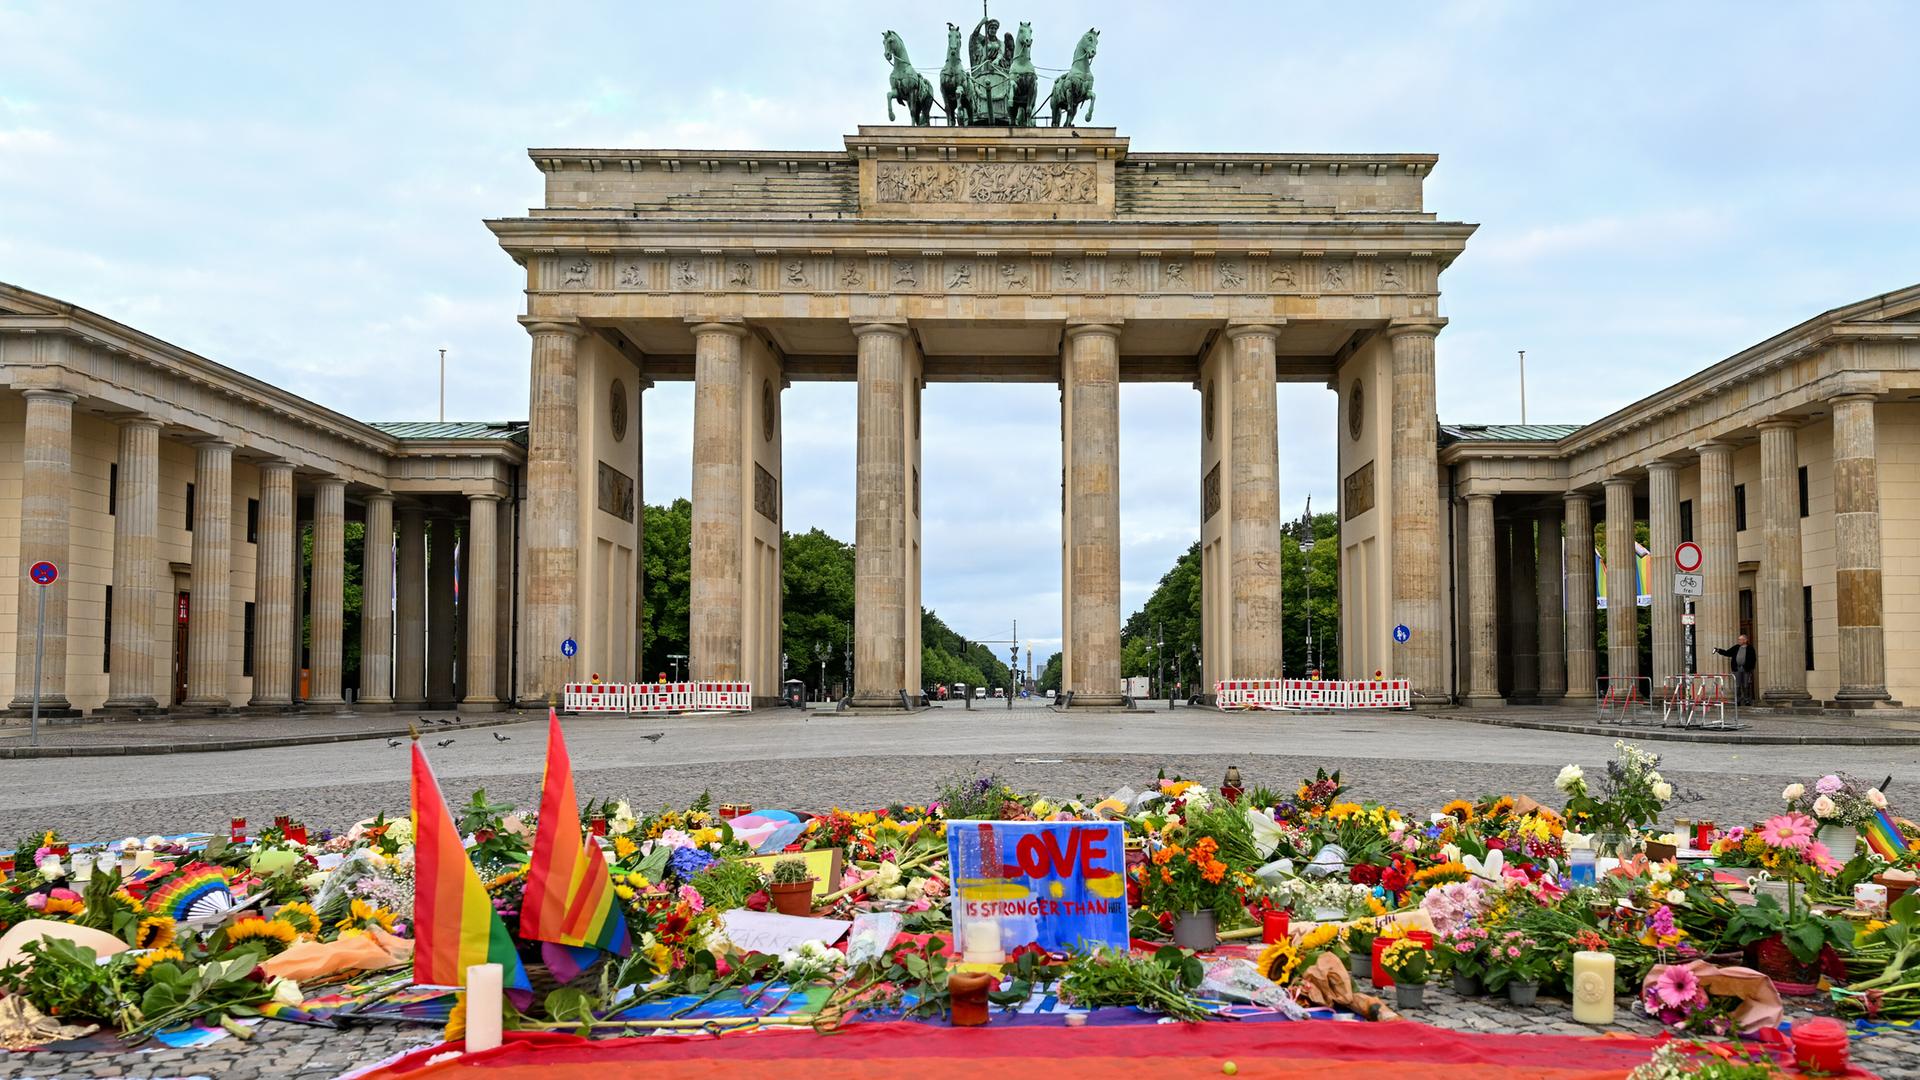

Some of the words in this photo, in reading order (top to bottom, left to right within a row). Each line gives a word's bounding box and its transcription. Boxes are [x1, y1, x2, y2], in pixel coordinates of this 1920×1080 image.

[978, 823, 1114, 879] LOVE
[966, 902, 977, 916] IS
[981, 900, 1060, 917] STRONGER
[1062, 899, 1107, 916] THAN
